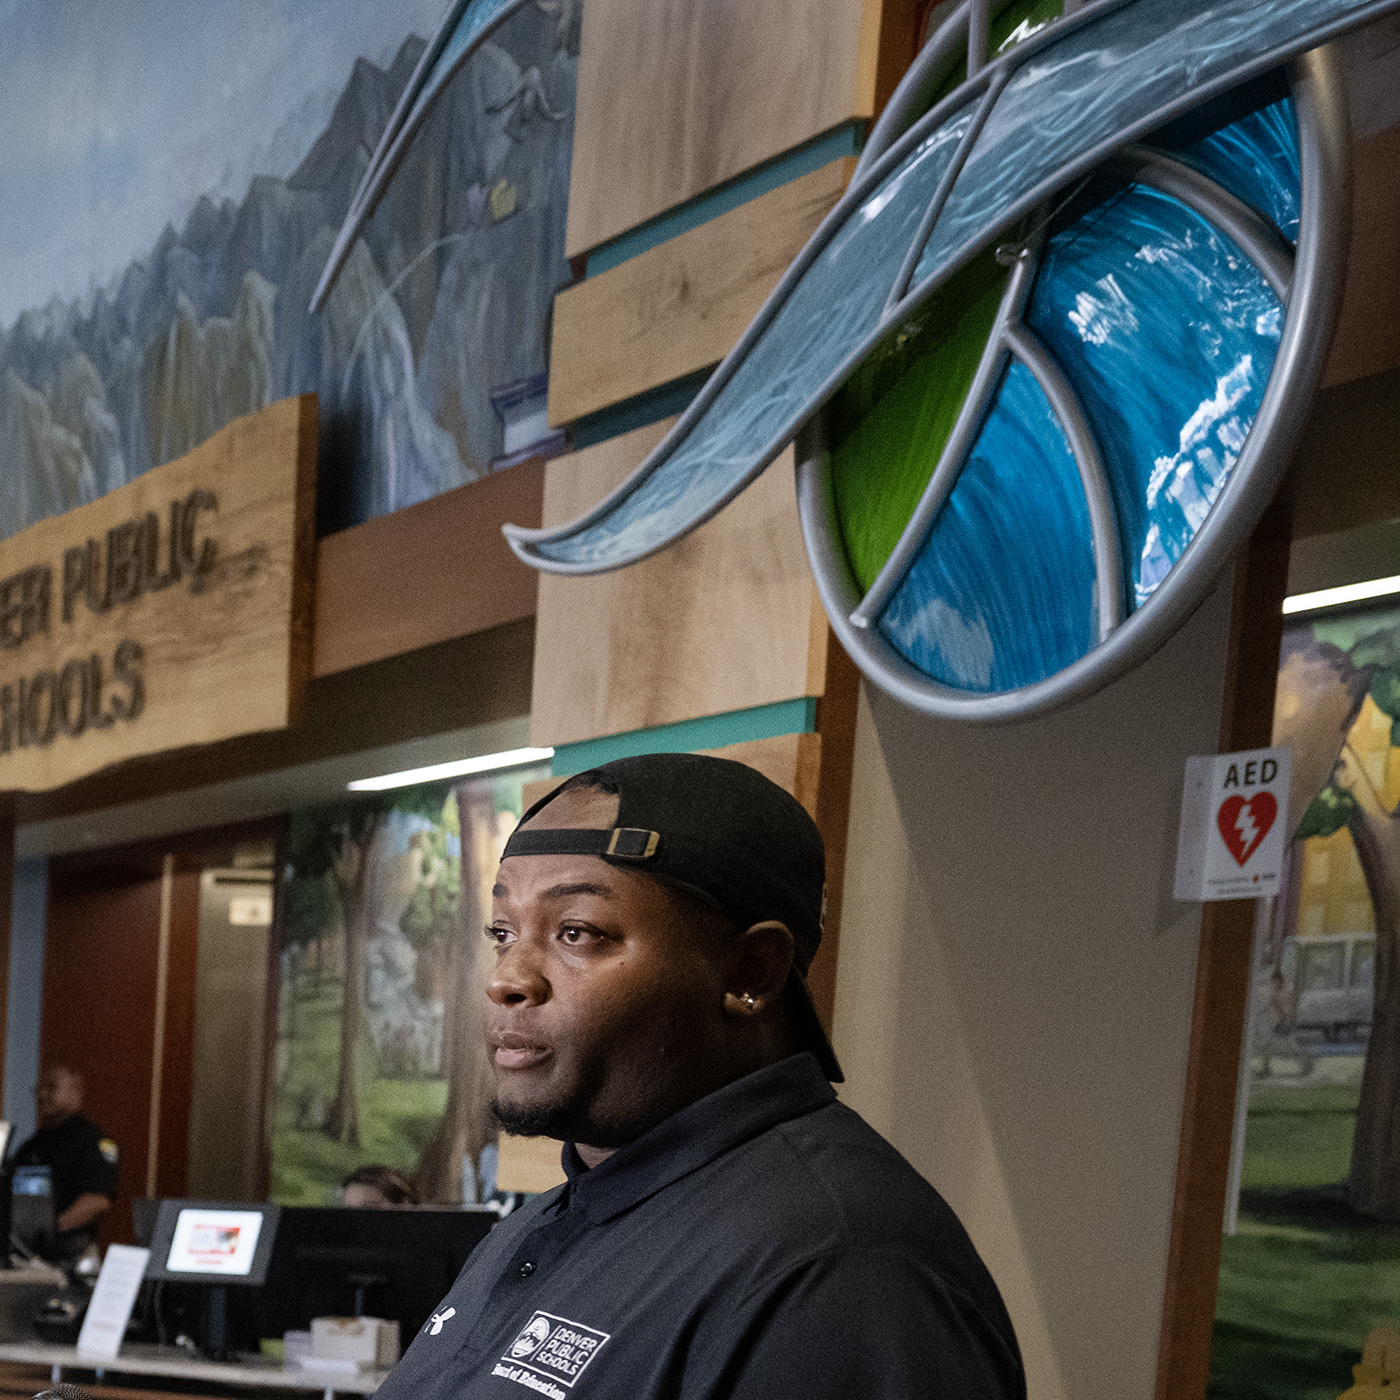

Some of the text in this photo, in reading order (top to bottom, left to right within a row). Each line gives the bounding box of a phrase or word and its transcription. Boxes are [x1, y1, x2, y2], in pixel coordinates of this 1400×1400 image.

[62, 488, 218, 624] PUBLIC
[1223, 758, 1279, 788] AED
[545, 1339, 589, 1365] PUBLIC
[554, 1327, 598, 1352] DENVER
[536, 1351, 580, 1375] SCHOOLS
